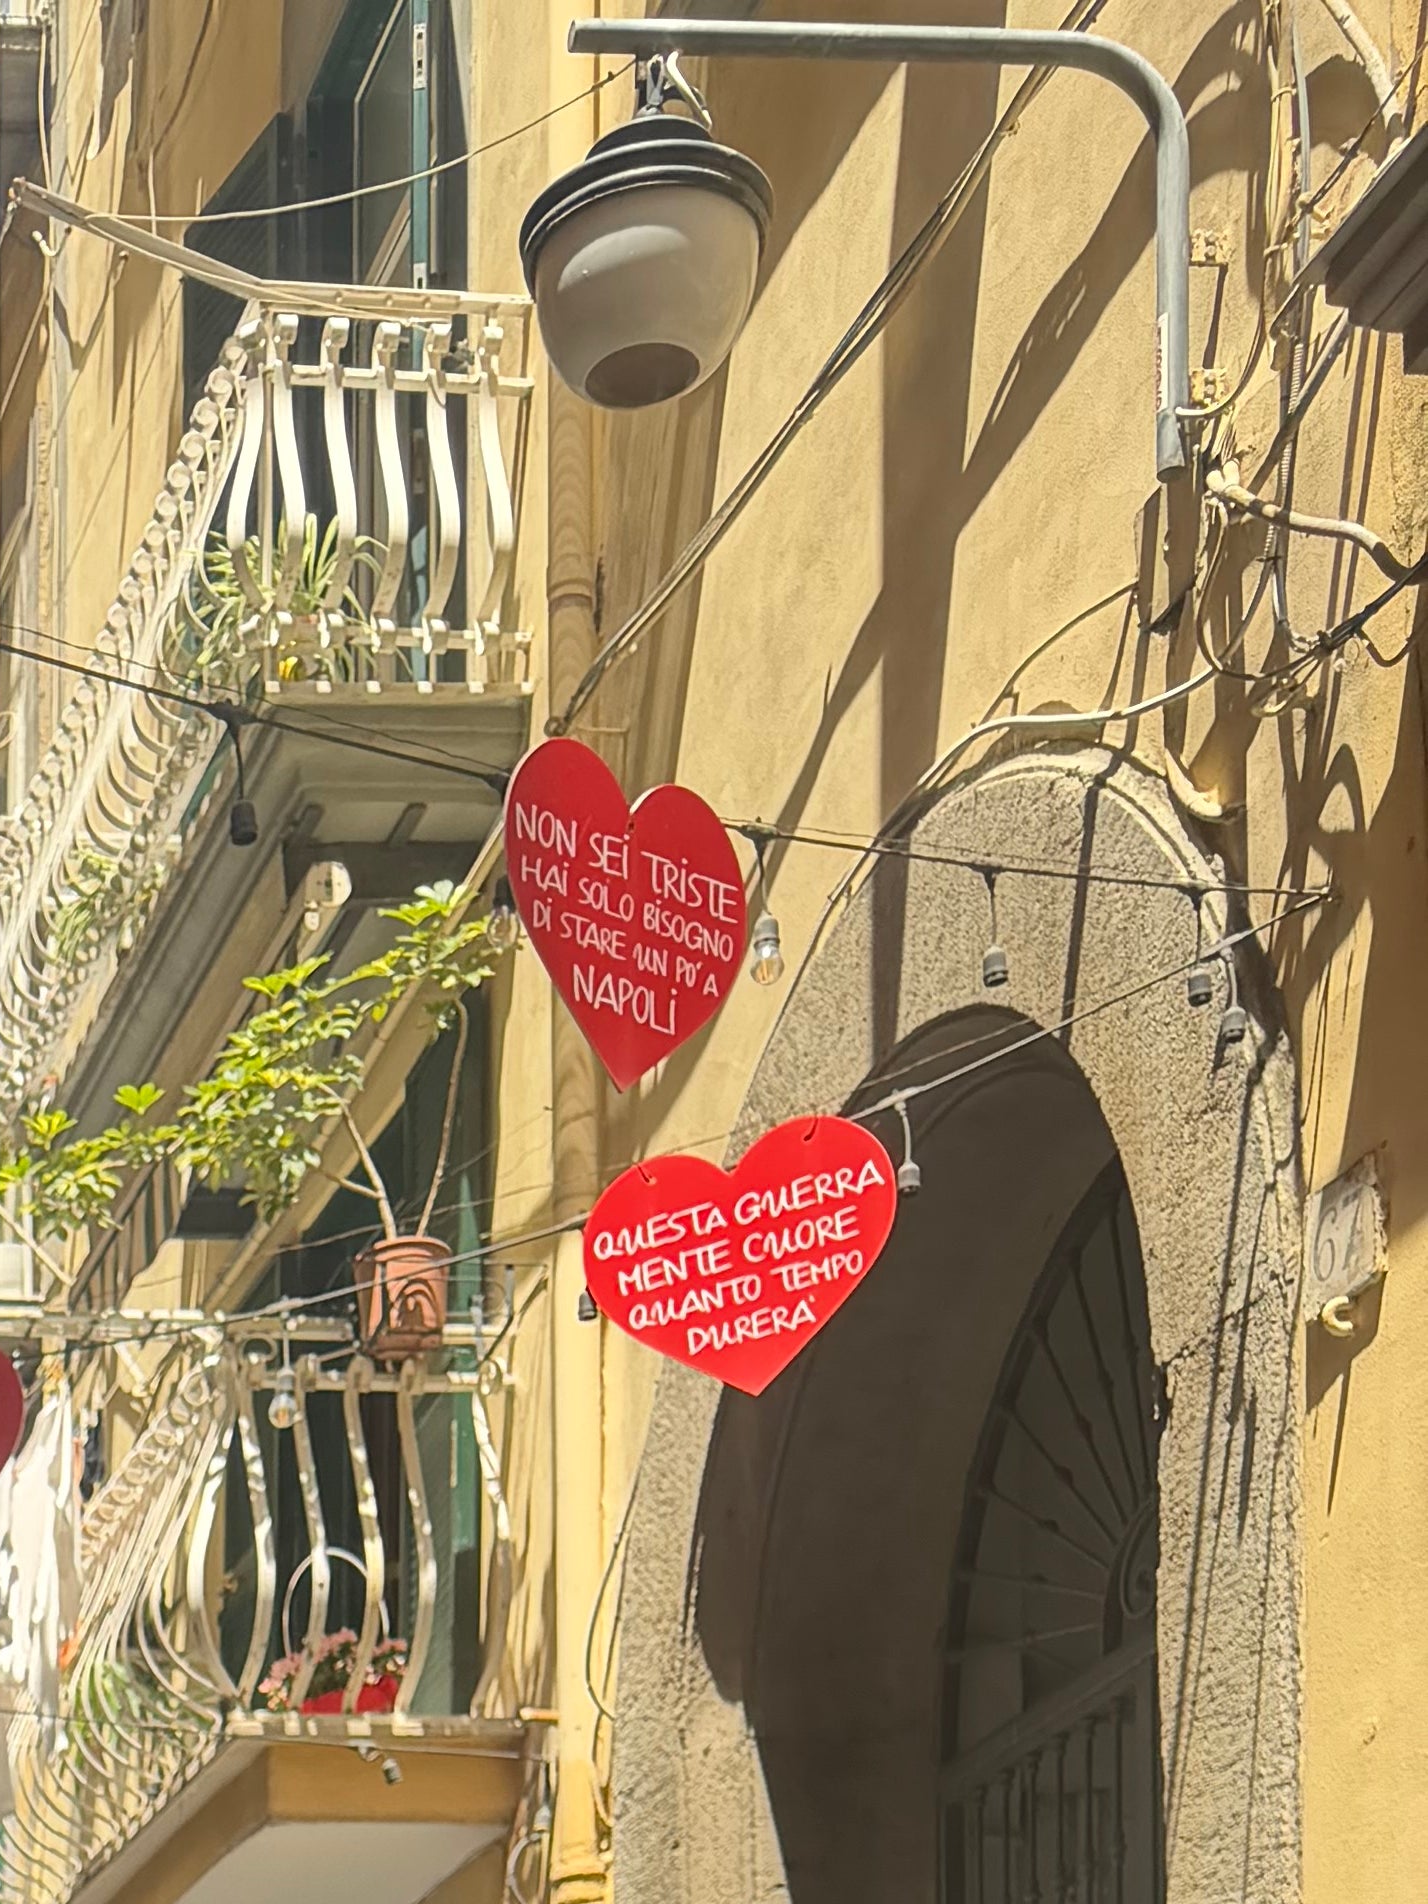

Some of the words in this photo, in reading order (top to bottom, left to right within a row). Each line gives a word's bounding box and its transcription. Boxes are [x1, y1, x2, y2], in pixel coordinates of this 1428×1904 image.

[515, 802, 578, 858] NON
[589, 833, 630, 880] SEI
[640, 850, 739, 925] TRISTE
[521, 855, 570, 897] HAI
[578, 876, 635, 923] SOLO
[643, 898, 734, 962] BISOGNO
[532, 897, 553, 932] DI
[560, 911, 628, 961] STARE
[632, 942, 668, 977] UN
[702, 973, 720, 998] A
[572, 962, 679, 1036] NAPOLI
[593, 1200, 728, 1260] QUESTA
[733, 1159, 886, 1226] GUERRA
[616, 1238, 733, 1298] MENTE
[742, 1205, 861, 1263] CUORE
[628, 1273, 762, 1332] QUANTO
[769, 1249, 864, 1293] TEMPO
